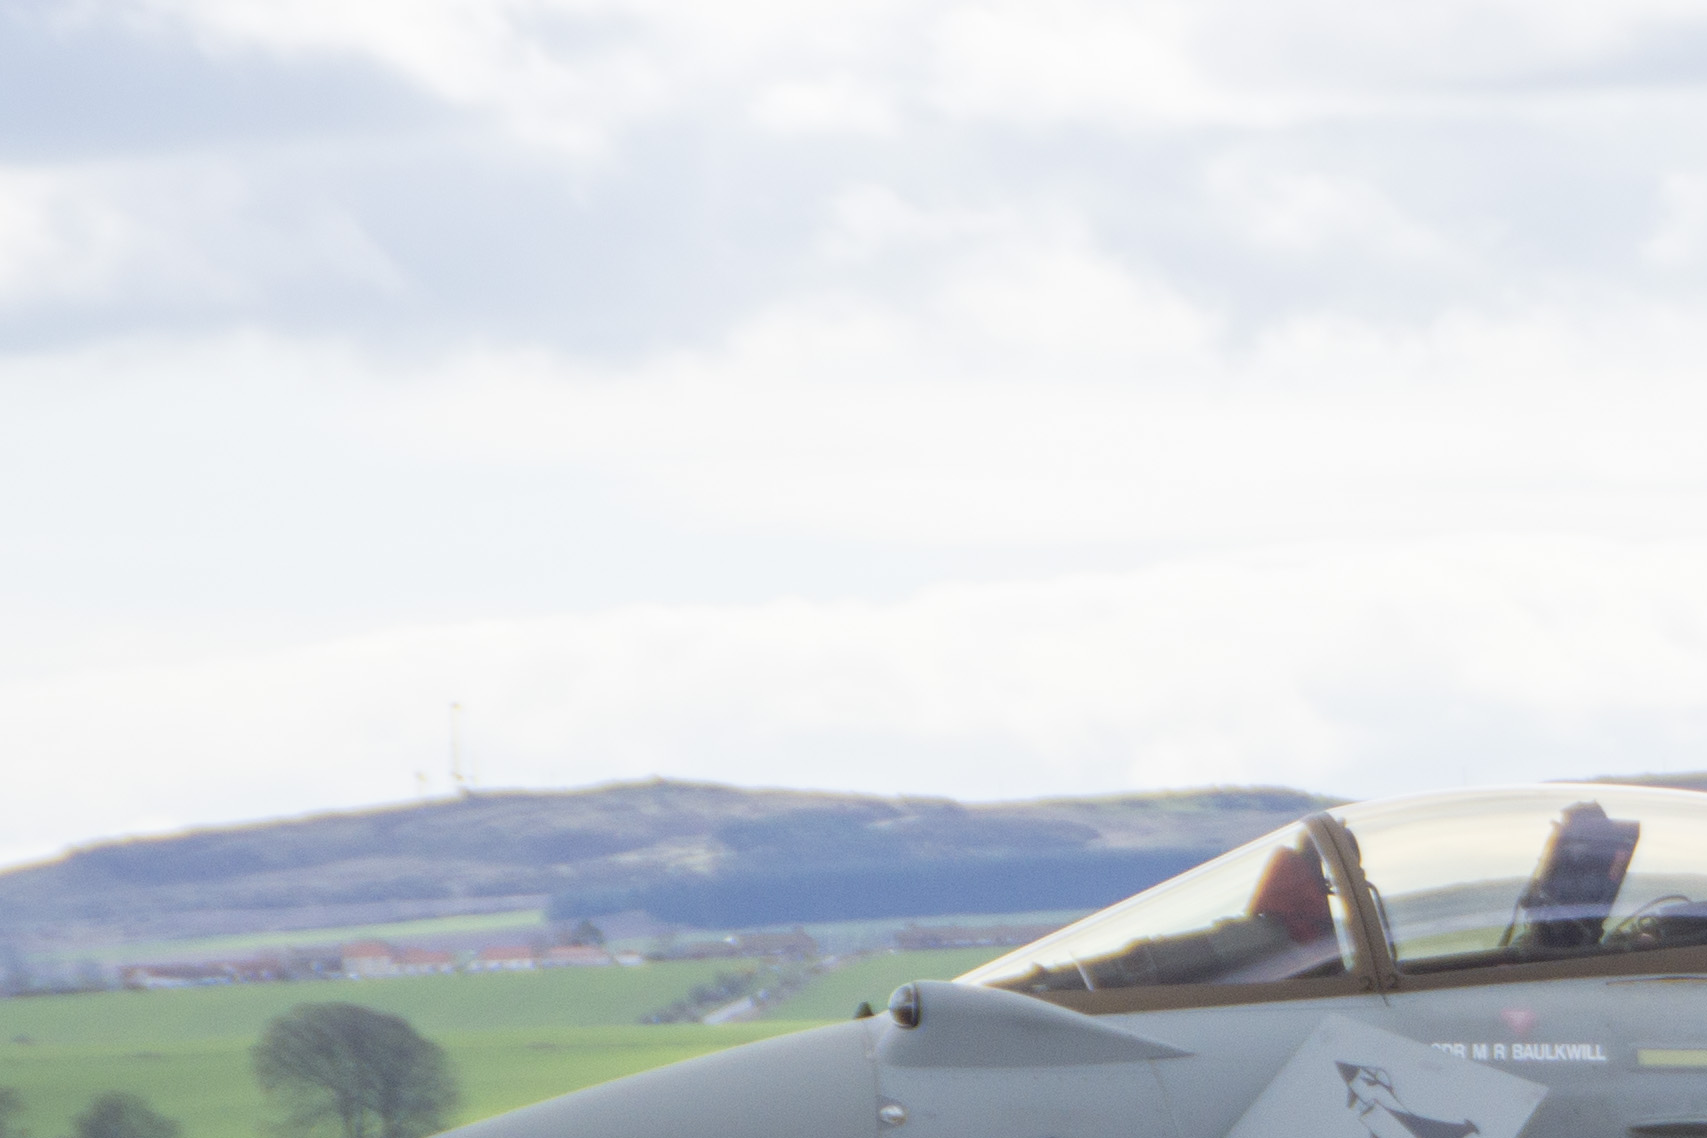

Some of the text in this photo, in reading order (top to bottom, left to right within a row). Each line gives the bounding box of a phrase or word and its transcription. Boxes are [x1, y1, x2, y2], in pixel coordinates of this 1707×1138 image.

[1473, 1044, 1487, 1060] M
[1494, 1044, 1505, 1060] R
[1512, 1043, 1607, 1061] BAULKWILL
